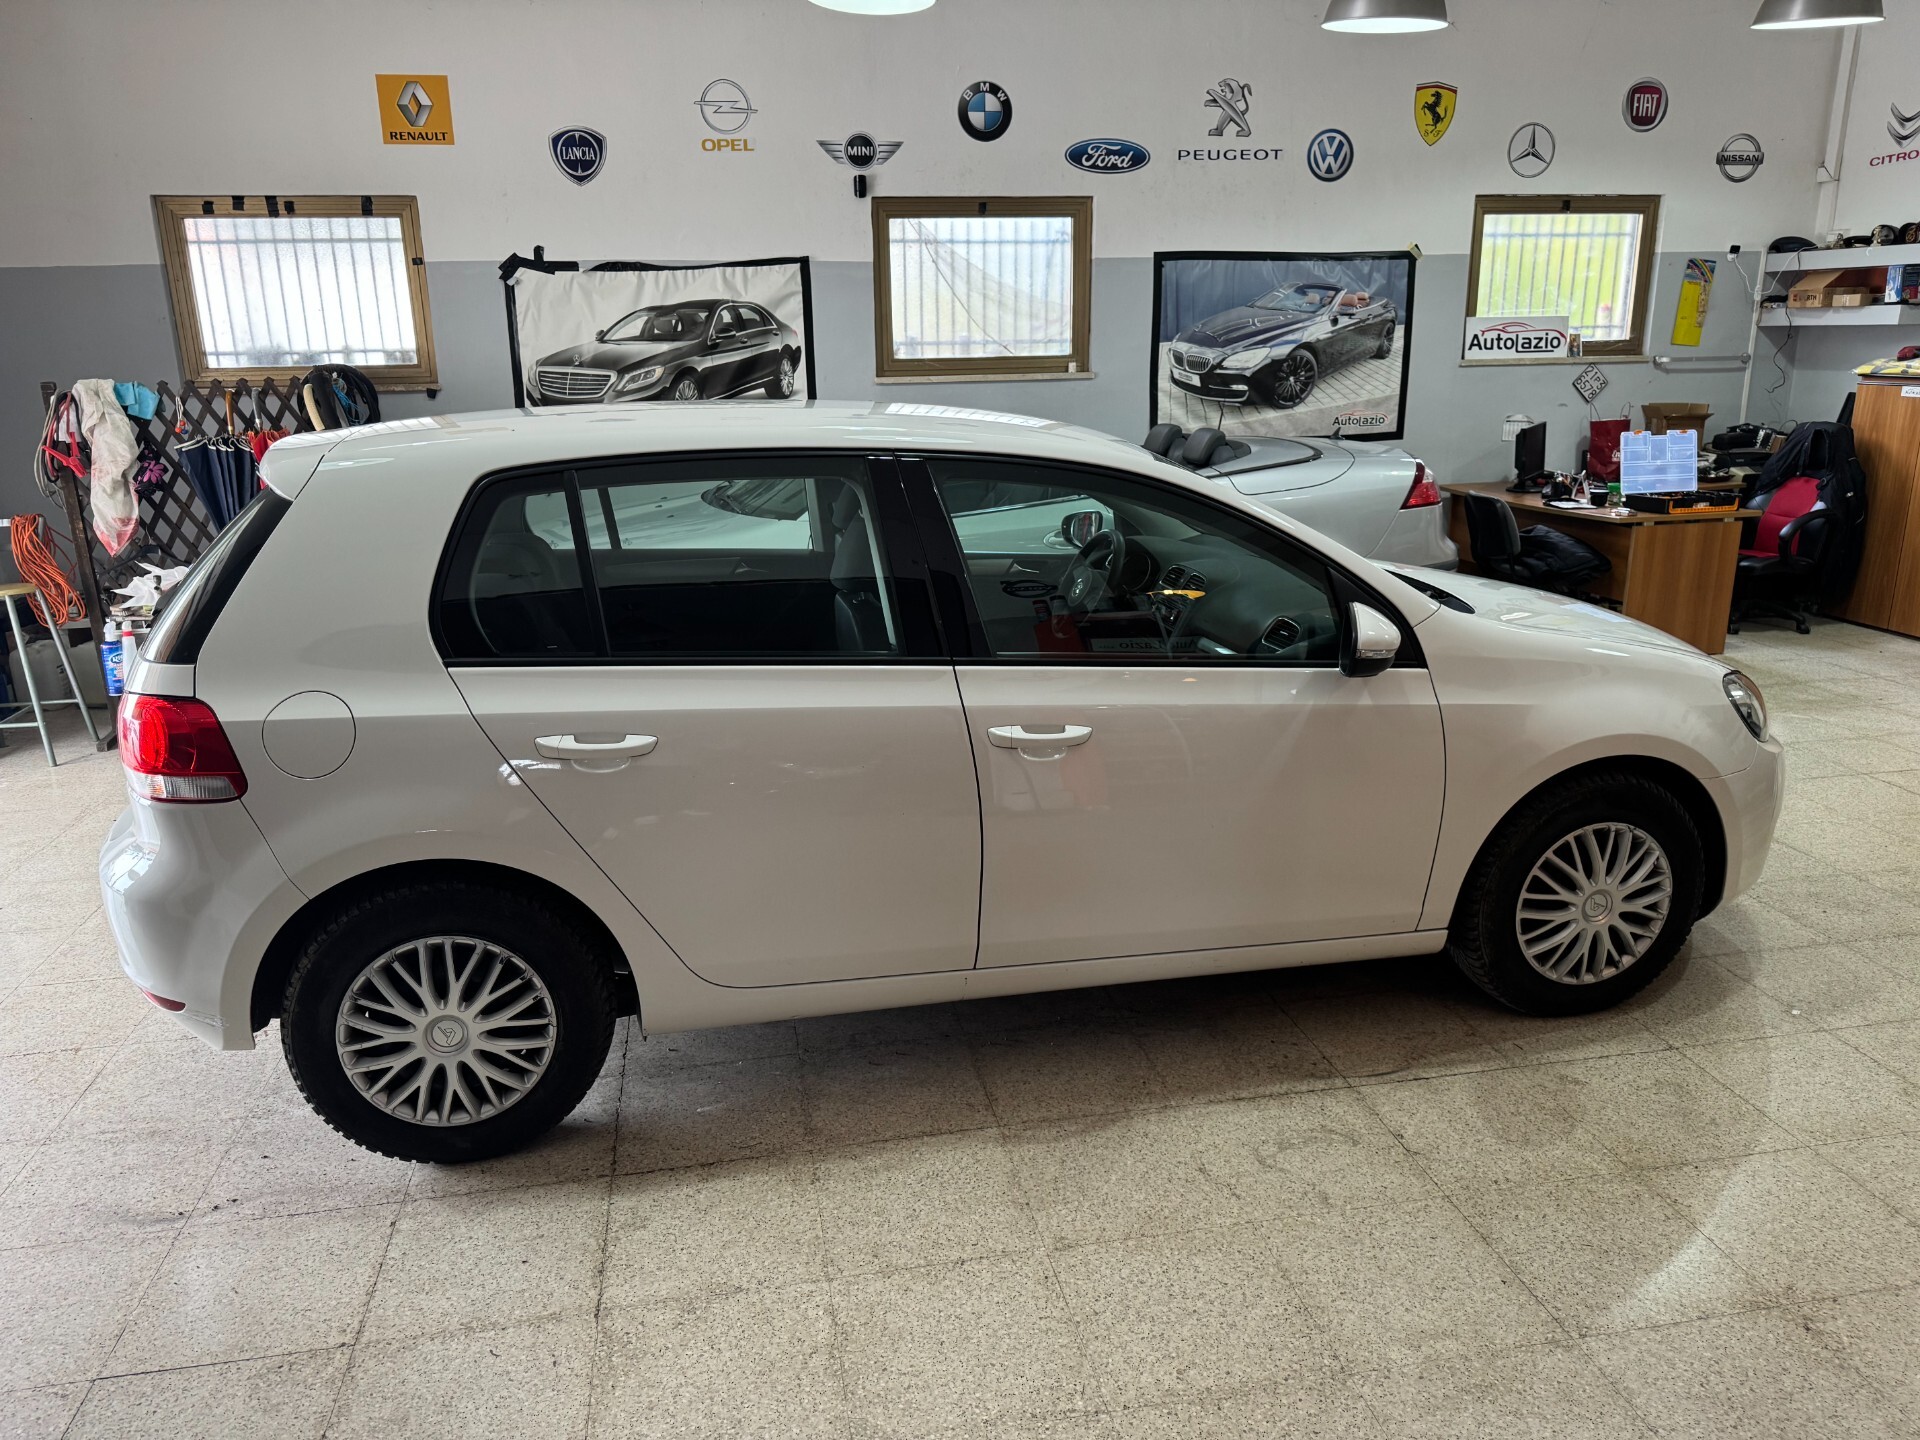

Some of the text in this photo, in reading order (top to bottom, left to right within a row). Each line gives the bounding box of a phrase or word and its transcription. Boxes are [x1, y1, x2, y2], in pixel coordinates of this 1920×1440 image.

[963, 82, 1007, 101] BMW
[1632, 93, 1660, 117] FIAT
[389, 131, 448, 141] RENAULT
[701, 138, 755, 152] OPEL
[847, 145, 874, 156] MINI
[562, 146, 596, 160] LANCIA
[1081, 143, 1134, 168] Ford
[1178, 149, 1283, 160] PEUGEOT
[1720, 154, 1760, 162] NISSAN
[1869, 149, 1920, 167] CITRO
